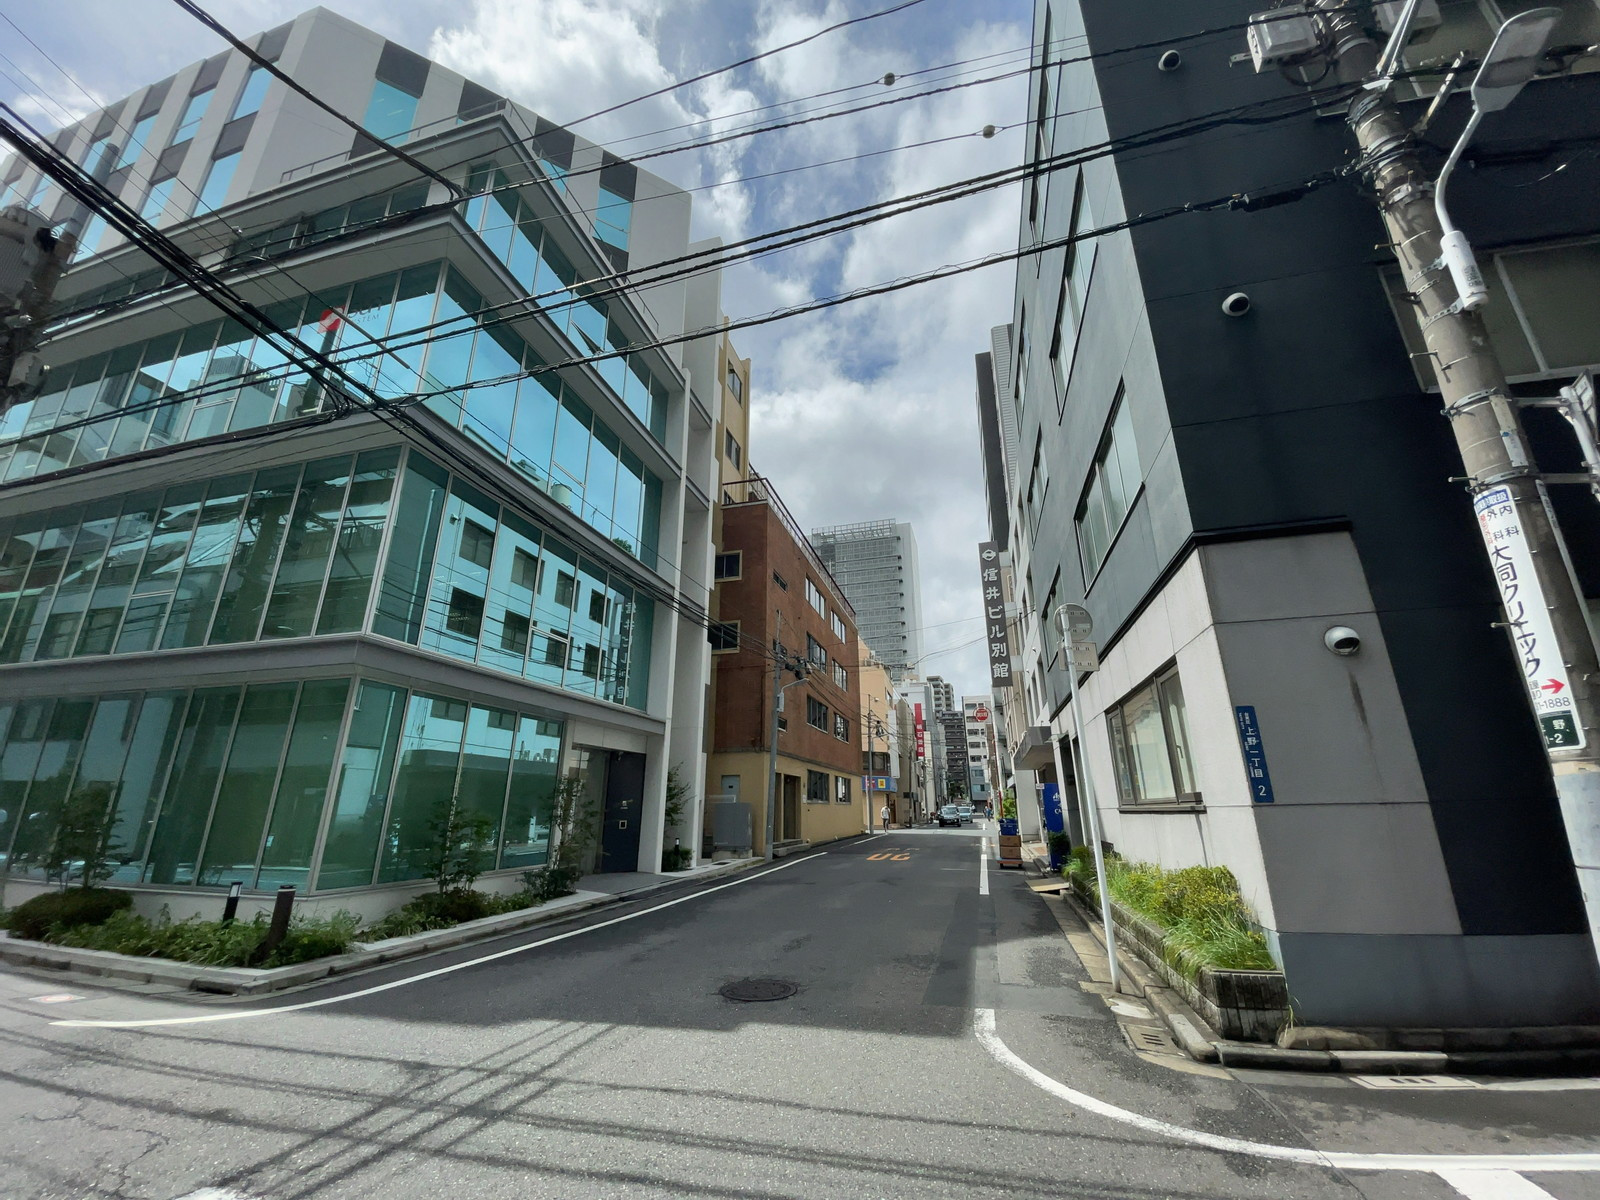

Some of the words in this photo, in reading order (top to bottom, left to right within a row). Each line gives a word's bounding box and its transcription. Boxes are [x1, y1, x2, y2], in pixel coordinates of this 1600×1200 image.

[1487, 508, 1504, 542] 外科
[1499, 504, 1520, 538] 内科
[983, 567, 1009, 679] 信井ビル別館
[1491, 545, 1541, 678] 大司クリニック
[1246, 726, 1264, 778] 上野一丁目
[1258, 785, 1267, 796] 2
